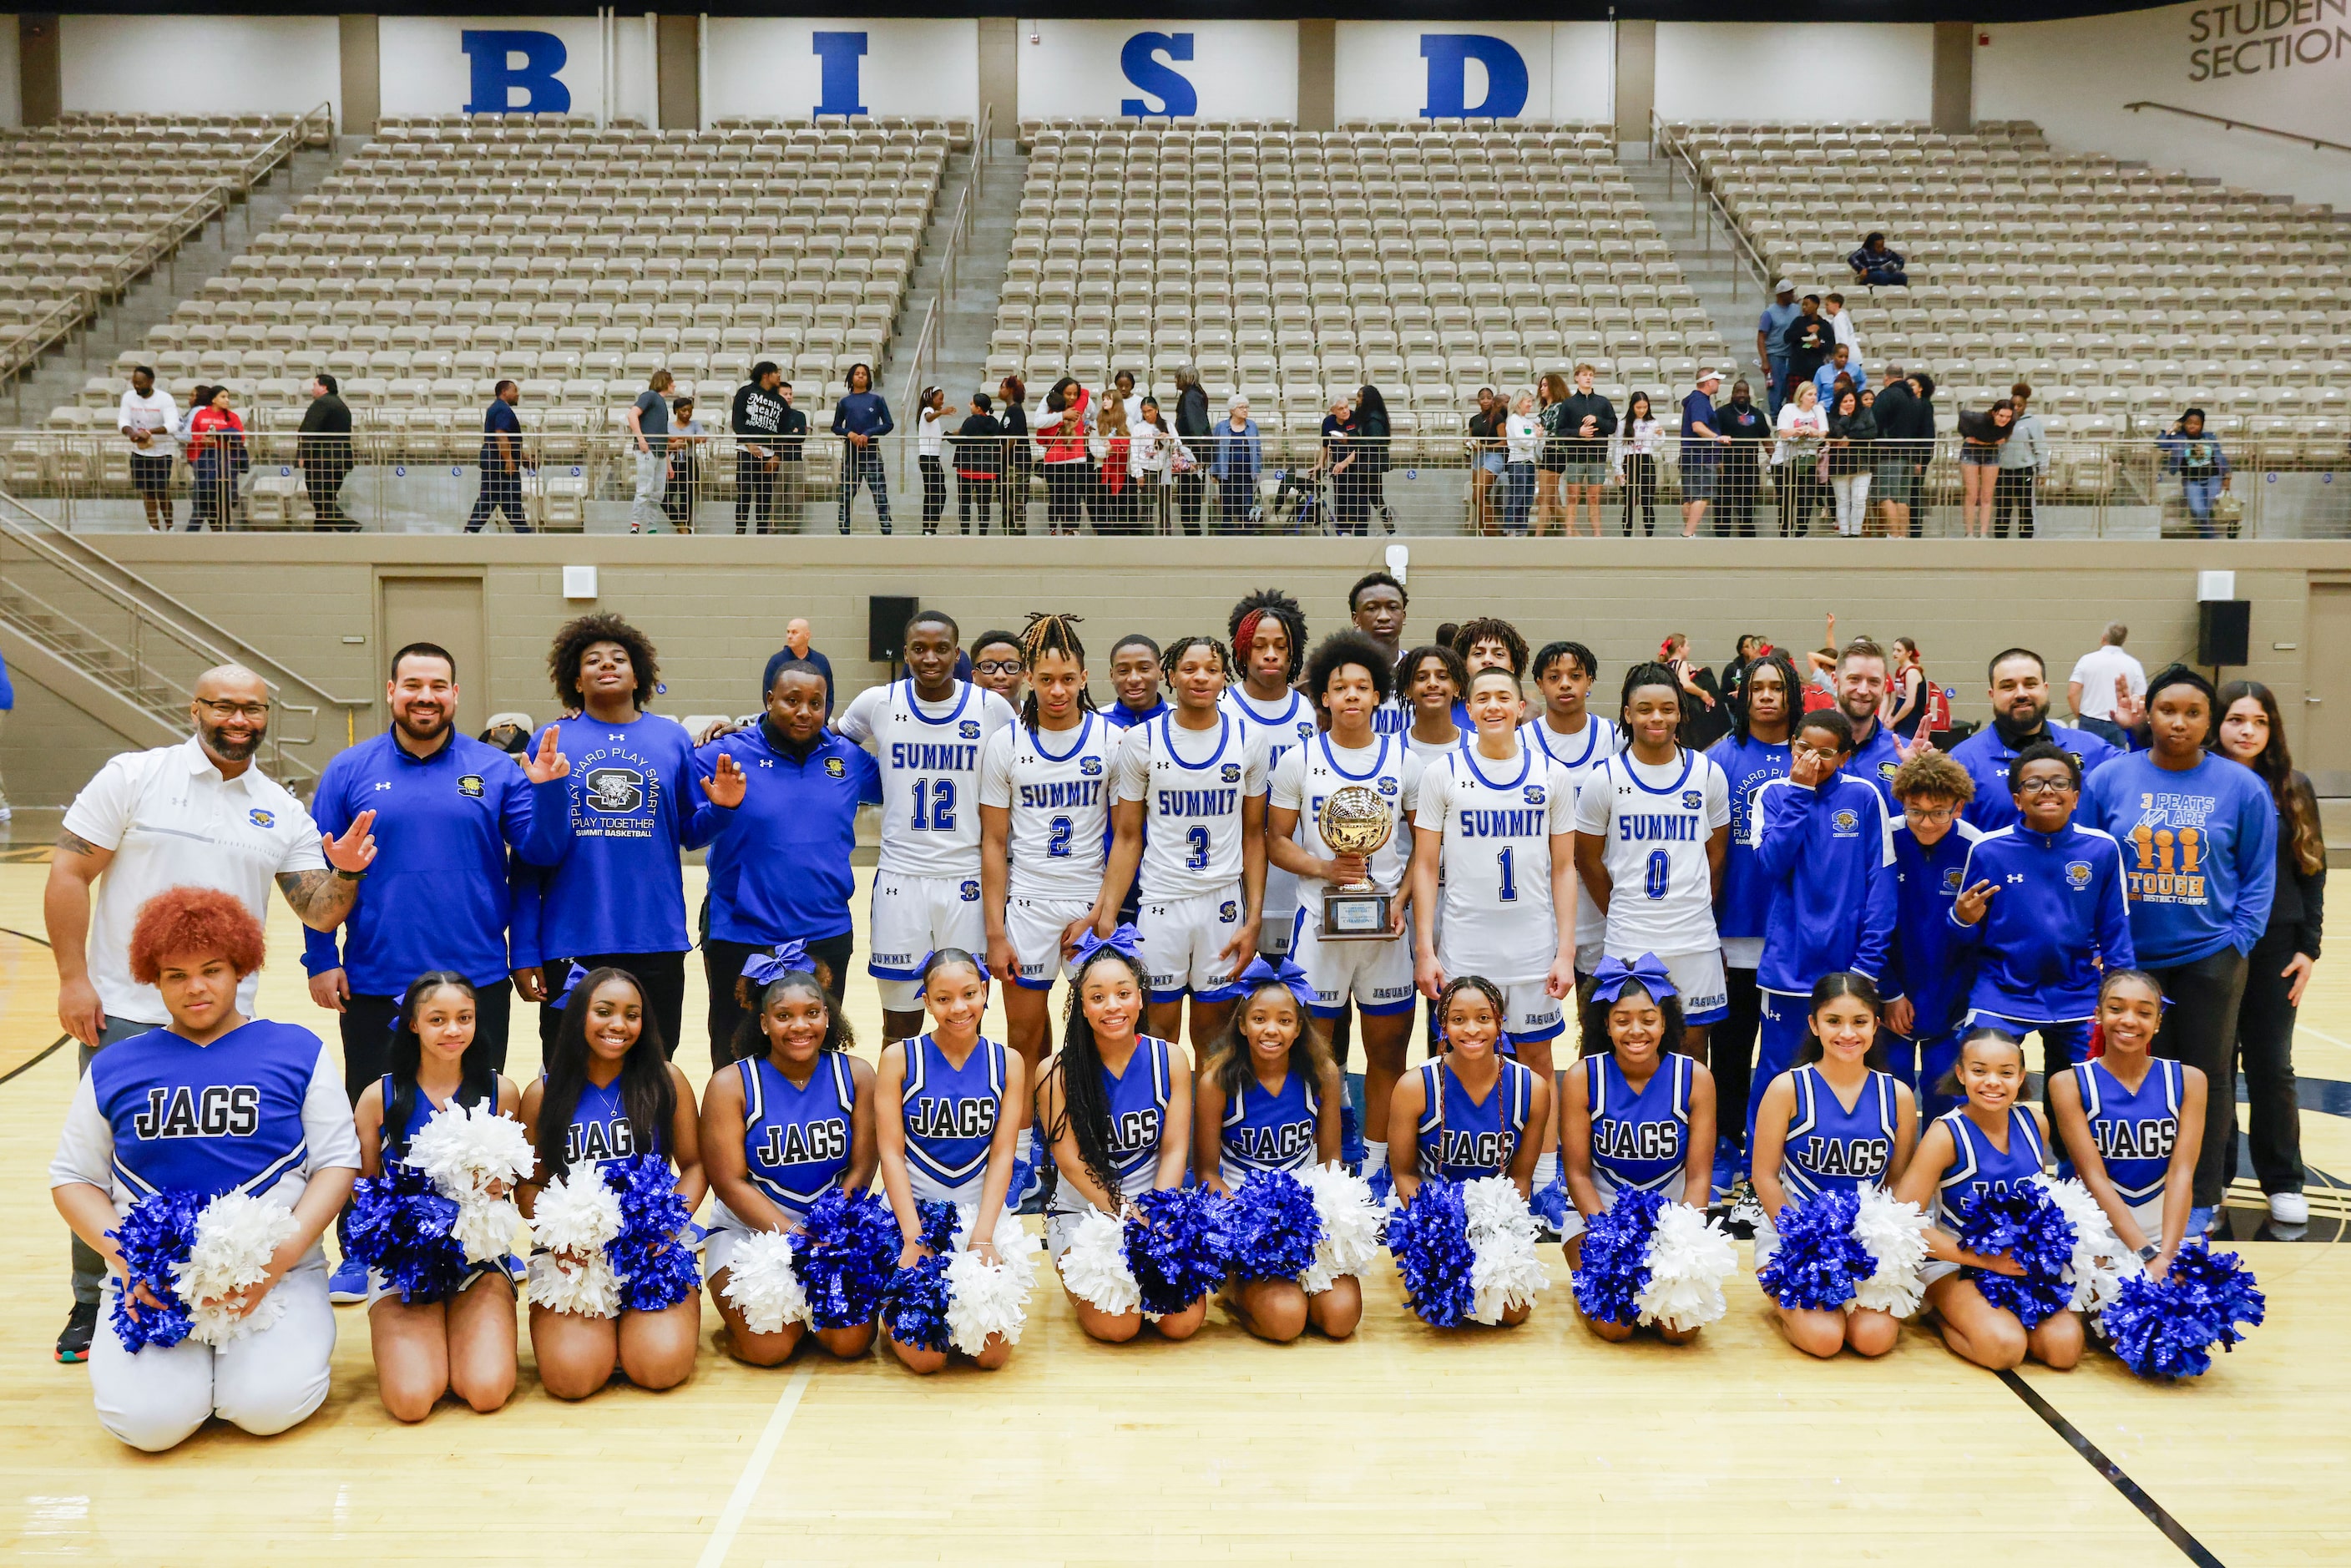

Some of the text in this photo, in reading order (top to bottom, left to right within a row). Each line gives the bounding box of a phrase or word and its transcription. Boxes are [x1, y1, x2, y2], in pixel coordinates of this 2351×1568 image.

[892, 742, 978, 771] SUMMIT
[572, 749, 607, 778] HARD
[612, 747, 649, 766] PLAY
[645, 768, 660, 817] SMART
[1020, 779, 1103, 808] SUMMIT
[1159, 787, 1237, 817] SUMMIT
[1735, 769, 1767, 796] HARD
[2141, 792, 2215, 813] 3 PEATS
[571, 817, 655, 829] PLAY TOGETHER
[911, 778, 957, 831] 12
[1460, 808, 1545, 838] SUMMIT
[1732, 798, 1743, 827] PLAY
[2172, 810, 2207, 827] ARE
[605, 829, 653, 837] BASKETBALL
[1047, 815, 1074, 857] 2
[1186, 825, 1211, 871] 3
[1619, 813, 1700, 842] SUMMIT
[1498, 846, 1518, 902] 1
[1644, 847, 1671, 901] 0
[2128, 872, 2205, 898] TOUGH
[2143, 894, 2177, 903] DISTRICT
[2178, 897, 2208, 906] CHAMPS
[134, 1085, 260, 1141] JAGS
[909, 1096, 995, 1138] JAGS
[1106, 1107, 1159, 1152] AGS
[563, 1117, 635, 1165] JAG
[756, 1117, 846, 1167] JAGS
[1232, 1118, 1313, 1161] JAGS
[1430, 1130, 1514, 1168] JAGS
[1595, 1118, 1678, 1160] JAGS
[1797, 1136, 1888, 1177] JAGS
[2093, 1118, 2177, 1160] JAGS
